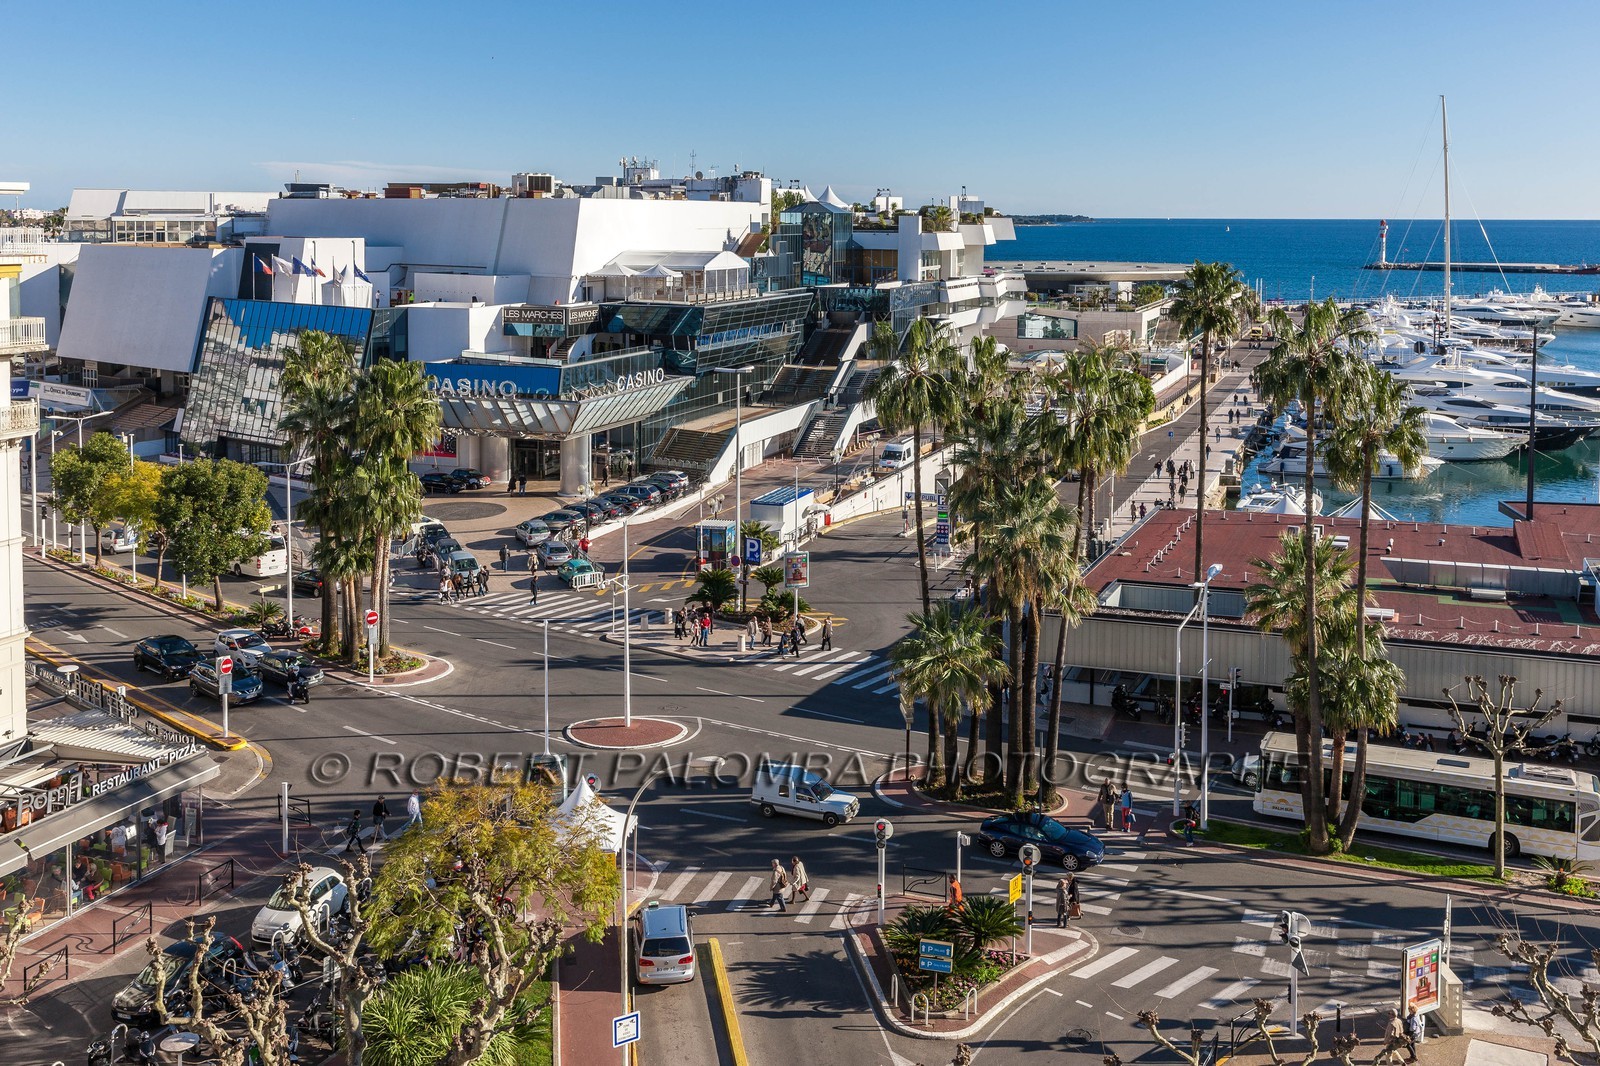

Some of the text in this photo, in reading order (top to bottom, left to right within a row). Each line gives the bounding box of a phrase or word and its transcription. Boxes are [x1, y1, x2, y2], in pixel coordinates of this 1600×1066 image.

[504, 309, 563, 319] LES MARCHES
[570, 311, 579, 320] LES
[617, 367, 665, 392] CASINO
[746, 539, 759, 558] P
[92, 758, 161, 797] RESTAURANT
[169, 743, 197, 764] PIZZA
